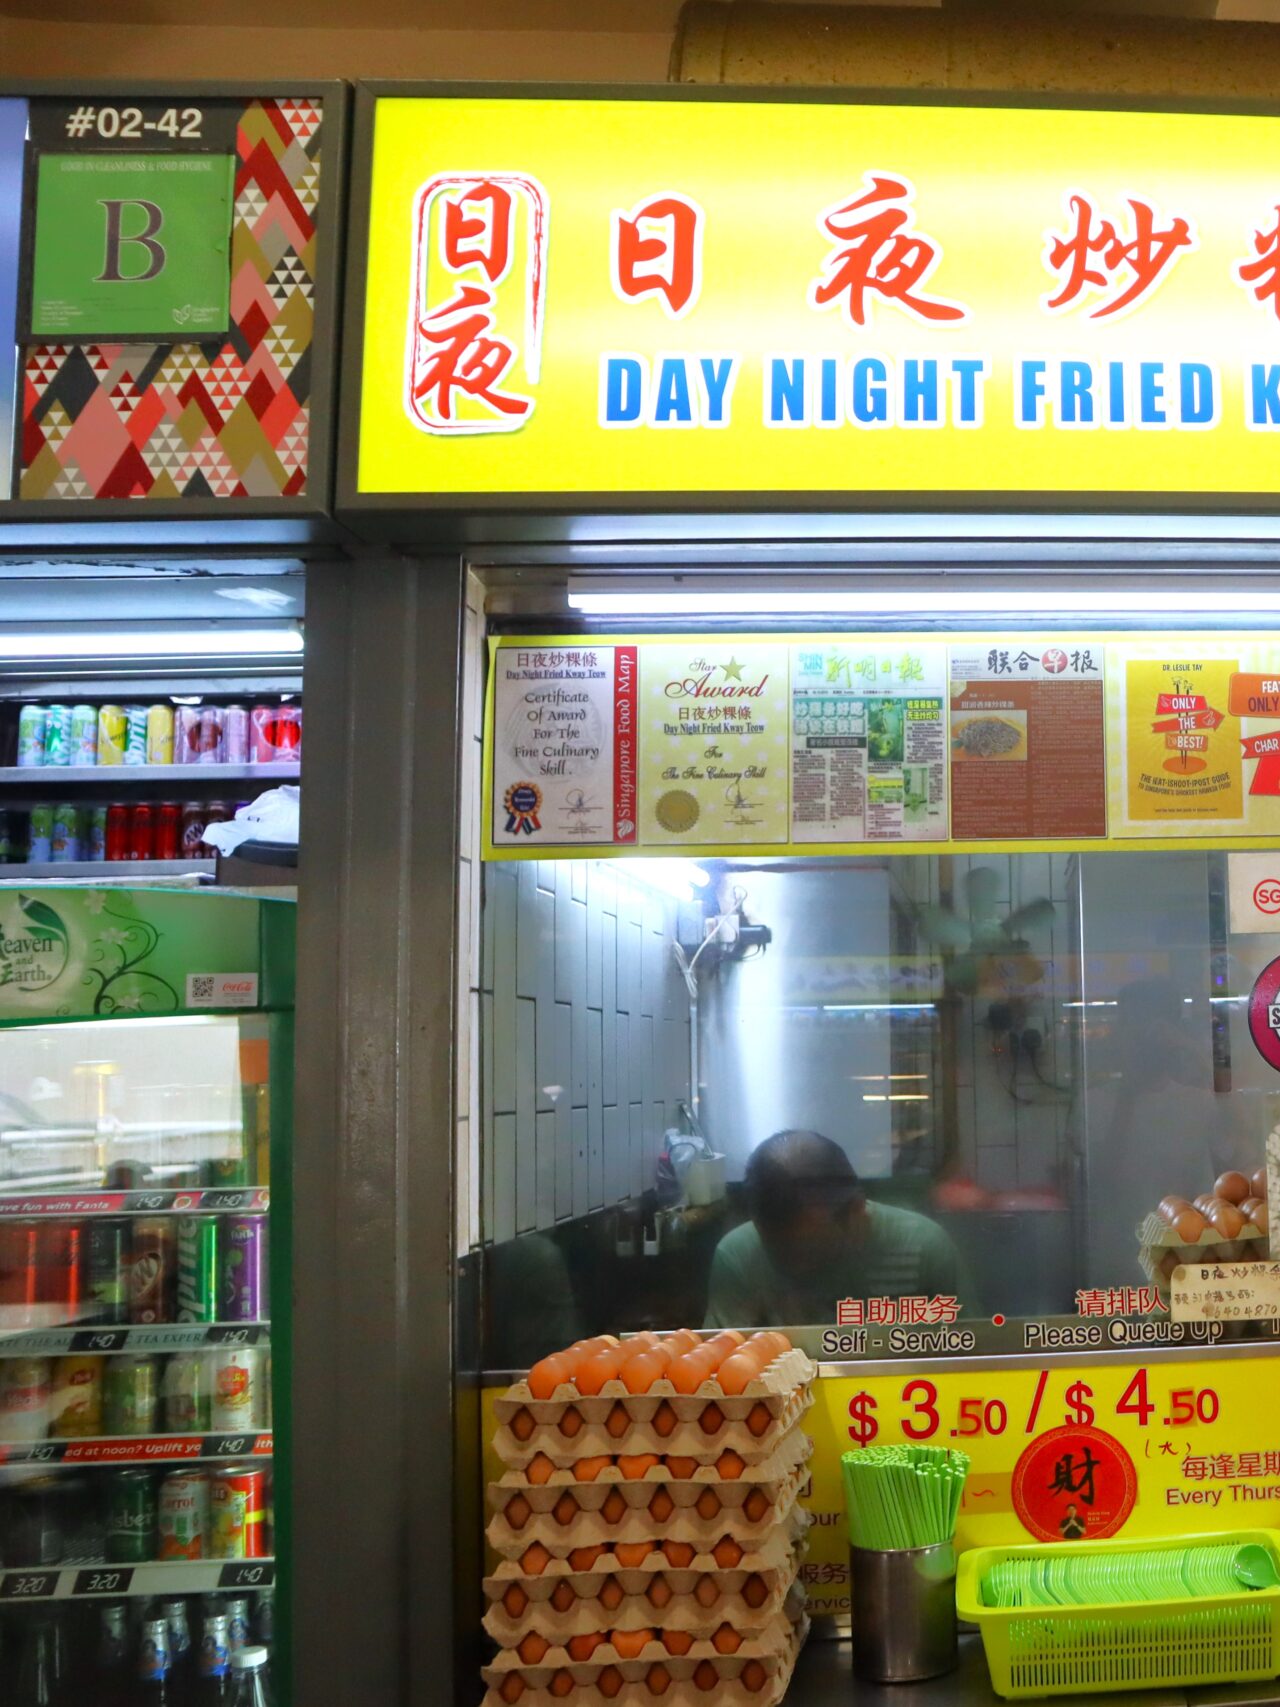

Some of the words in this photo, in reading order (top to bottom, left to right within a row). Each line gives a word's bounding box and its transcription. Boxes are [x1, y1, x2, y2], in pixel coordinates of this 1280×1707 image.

[65, 106, 202, 138] #02-42
[93, 199, 166, 282] B
[412, 180, 528, 419] 日夜
[606, 359, 732, 421] DAY
[771, 358, 982, 422] NIGHT
[1022, 360, 1213, 423] FRIED
[517, 651, 597, 668] 日夜炒粿條
[988, 648, 1099, 675] 联合早报
[506, 670, 520, 680] Day
[522, 670, 542, 680] Night
[544, 670, 563, 679] Fried
[618, 654, 635, 692] Map
[665, 671, 769, 698] Award
[525, 688, 589, 706] Certificate
[1172, 697, 1196, 710] ONLY
[1248, 697, 1280, 712] ONLY
[527, 706, 543, 724] Of
[548, 709, 586, 721] Award
[617, 699, 631, 734] Food
[678, 706, 752, 721] 日夜炒粿條
[534, 728, 552, 739] For
[556, 724, 580, 739] The
[664, 723, 678, 736] Day
[680, 723, 700, 735] Night
[702, 723, 721, 734] Fried
[724, 723, 744, 734] Kway
[1178, 717, 1196, 730] THE
[515, 747, 538, 758] Fine
[542, 742, 600, 760] Culinary
[1177, 736, 1204, 749] BEST!
[1254, 739, 1279, 753] CHAR
[617, 739, 635, 818] Singapore
[16, 955, 34, 965] and
[22, 1202, 42, 1212] fun
[46, 1201, 70, 1211] with
[75, 1200, 109, 1210] Fanta
[1075, 1285, 1170, 1318] 请排队
[836, 1295, 962, 1327] 自助服务
[136, 1335, 159, 1345] TEA
[822, 1328, 867, 1354] Self
[889, 1327, 975, 1352] Service
[1024, 1322, 1102, 1348] Please
[1108, 1318, 1184, 1345] Queue
[1191, 1320, 1223, 1344] Up
[85, 1446, 98, 1456] at
[103, 1443, 142, 1456] noon?
[146, 1441, 182, 1455] Uplift
[1166, 1488, 1222, 1507] Every
